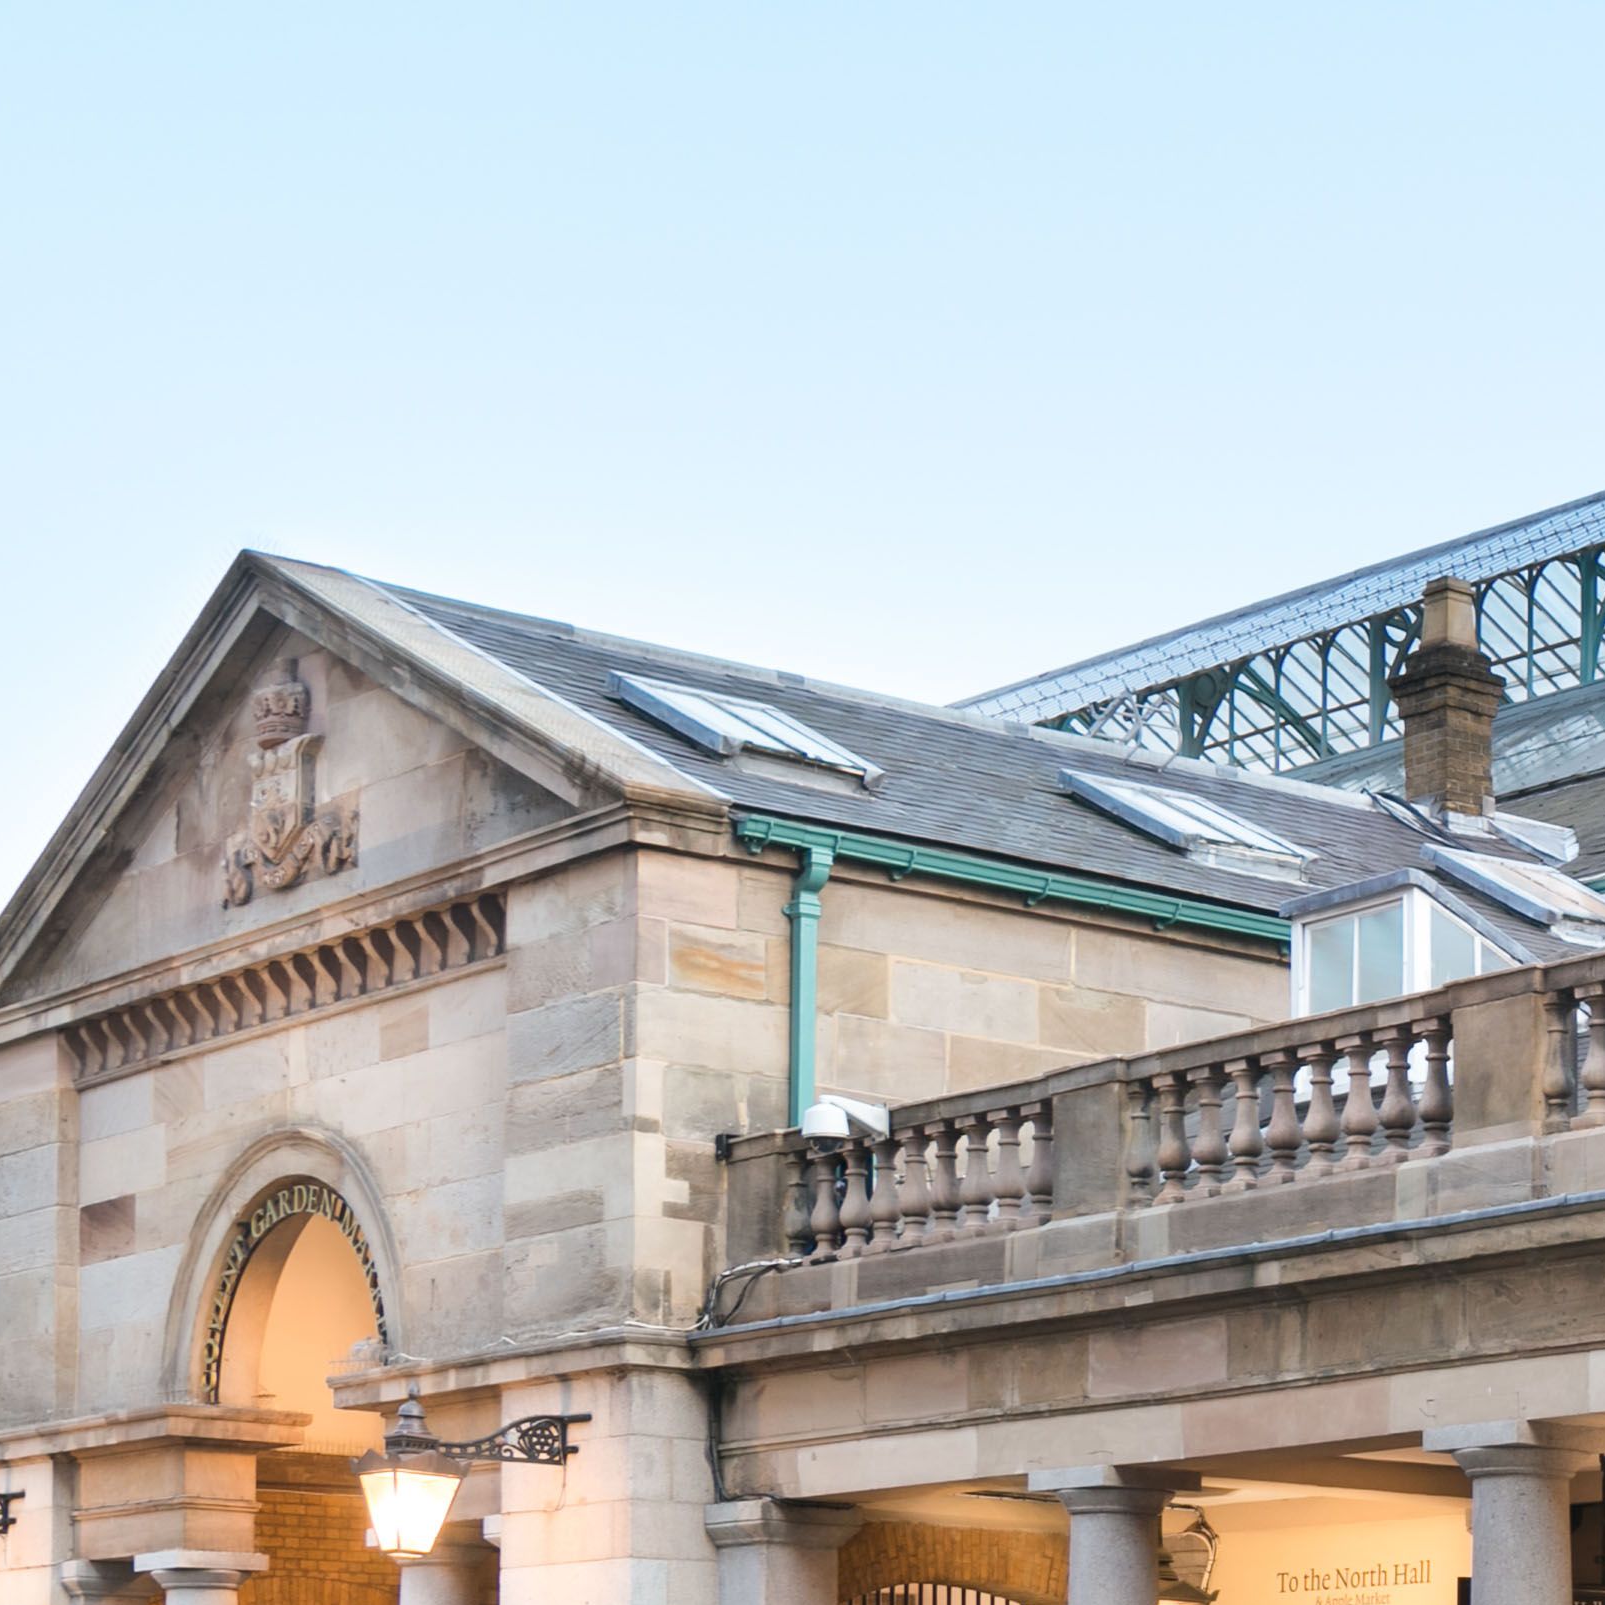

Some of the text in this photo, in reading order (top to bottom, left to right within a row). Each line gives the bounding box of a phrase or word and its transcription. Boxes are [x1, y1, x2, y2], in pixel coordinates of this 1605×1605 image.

[249, 1184, 338, 1240] GARDEN
[1277, 1560, 1432, 1593] To the North Hall
